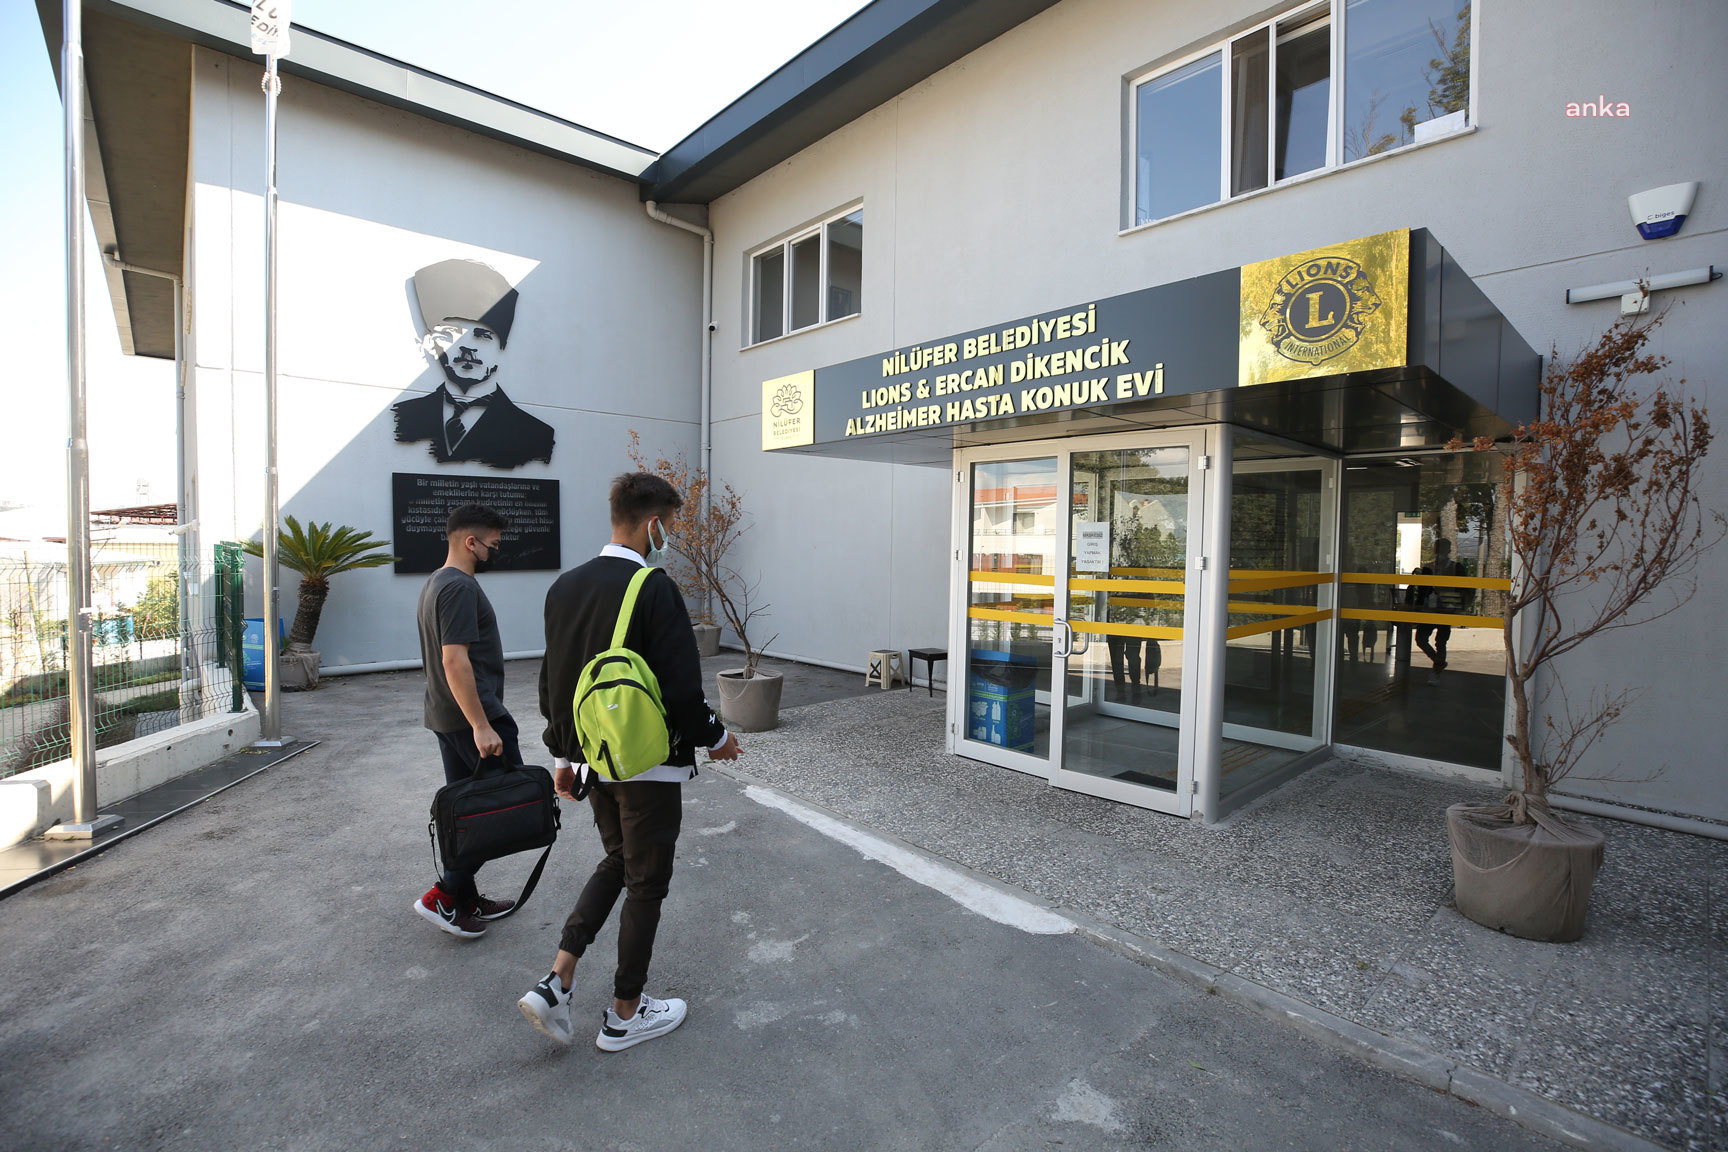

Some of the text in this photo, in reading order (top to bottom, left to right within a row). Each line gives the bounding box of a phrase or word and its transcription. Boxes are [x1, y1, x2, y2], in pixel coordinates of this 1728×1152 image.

[1285, 260, 1354, 290] LIONS
[1305, 291, 1334, 328] L
[882, 304, 1096, 378] NİLÜFER BELEDİYESİ
[1284, 334, 1352, 356] INTERNATIONAL
[862, 339, 1130, 409] LIONS & ERCAN DİKENCİK
[845, 362, 1164, 436] ALZHEİMER HASTA KONUK EVİ
[773, 416, 800, 428] NİLÜFER
